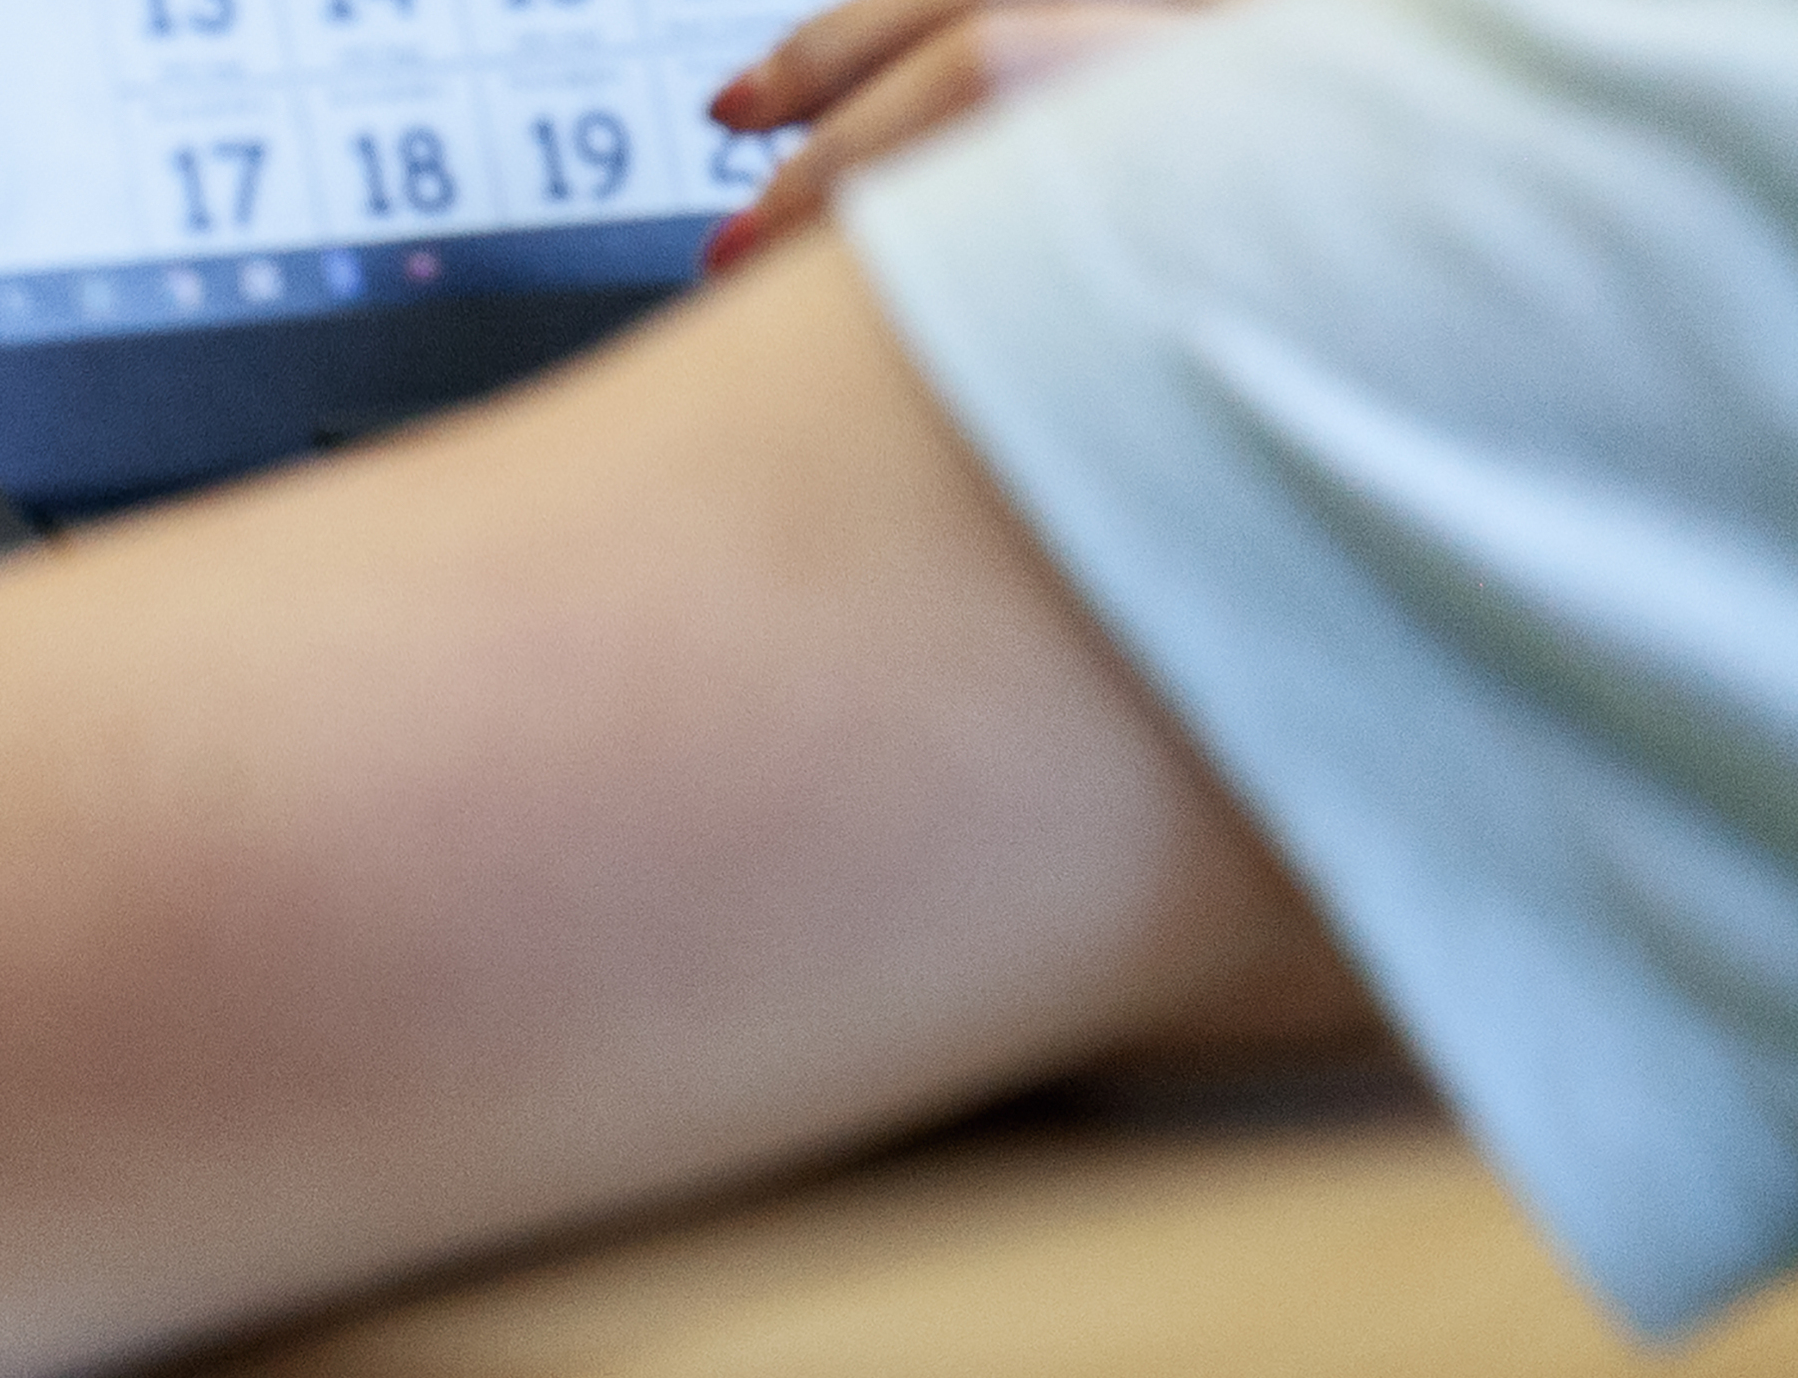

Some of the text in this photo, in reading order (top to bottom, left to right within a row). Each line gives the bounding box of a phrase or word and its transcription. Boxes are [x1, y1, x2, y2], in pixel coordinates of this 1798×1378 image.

[170, 137, 269, 234] 17
[352, 125, 458, 218] 18
[529, 108, 633, 202] 19
